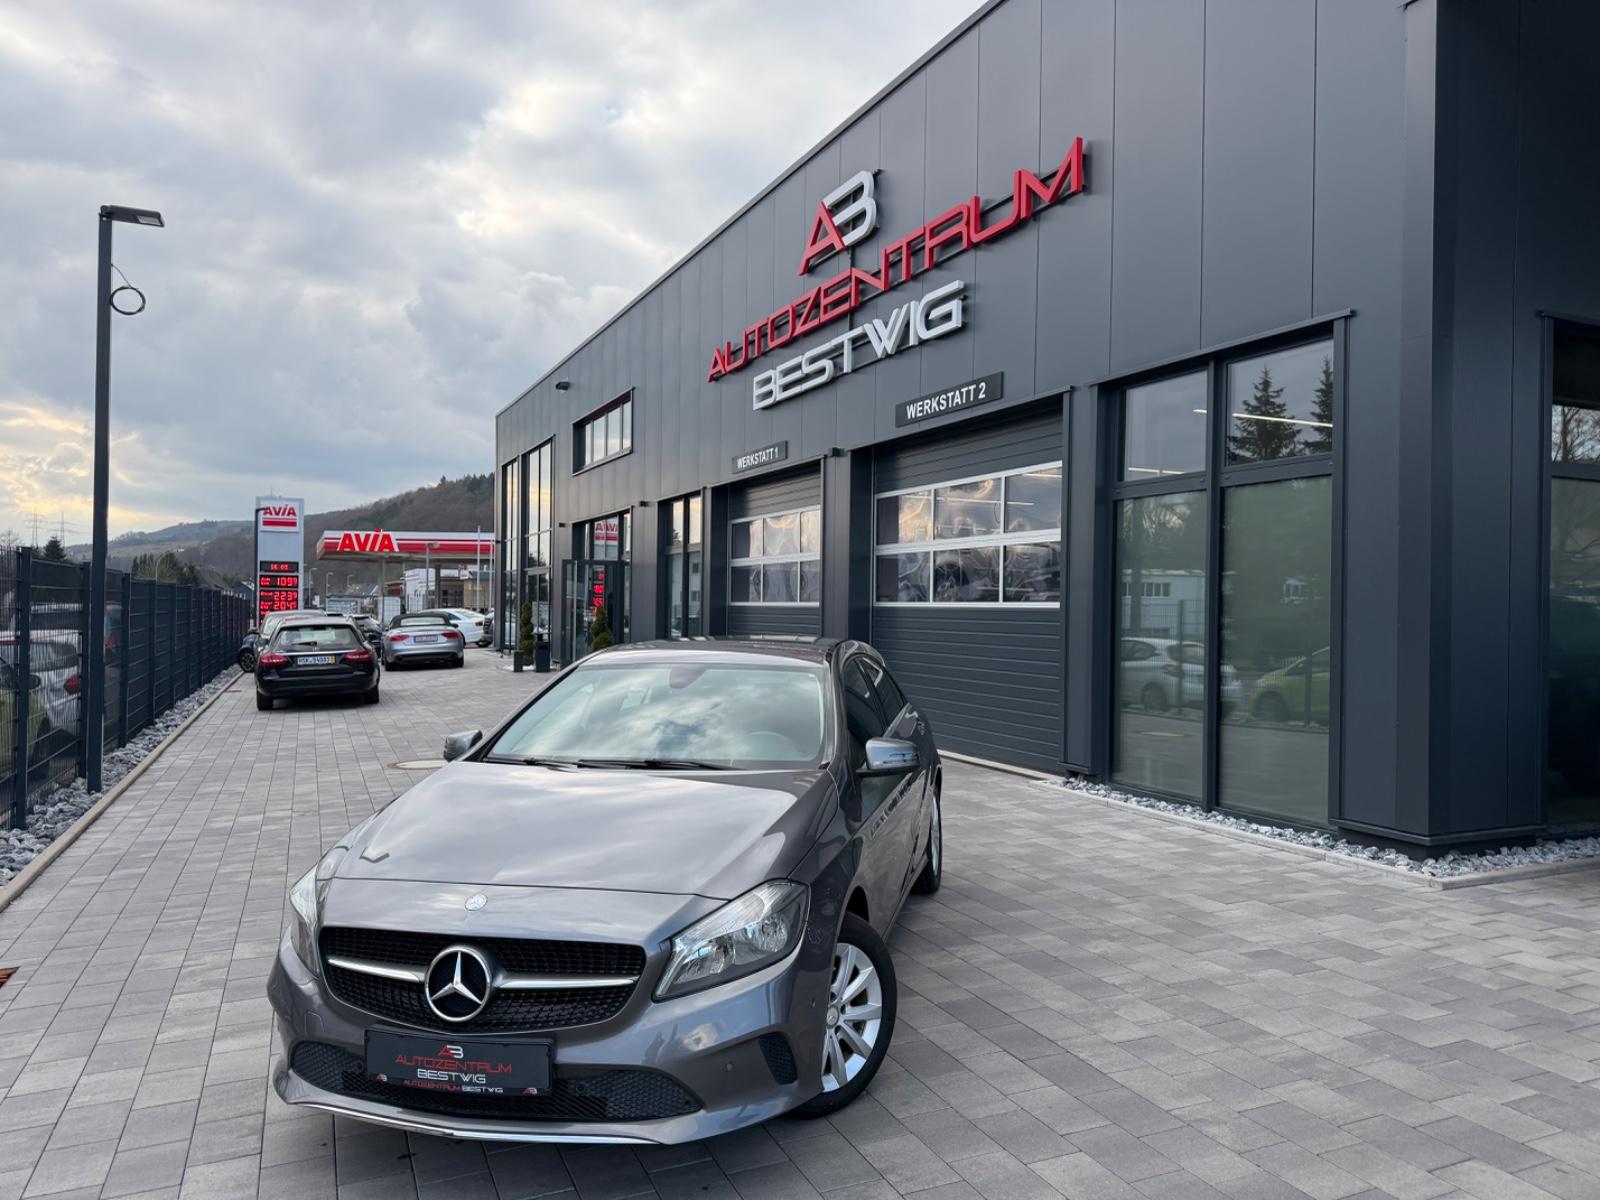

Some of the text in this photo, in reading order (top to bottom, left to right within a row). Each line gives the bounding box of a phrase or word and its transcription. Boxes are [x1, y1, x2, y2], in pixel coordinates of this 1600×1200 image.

[706, 135, 1084, 384] AUTOZENTRUM
[752, 279, 965, 412] BESTWIG
[906, 381, 987, 420] WERKSTATT 2
[736, 446, 779, 469] WERKSTATT 1
[262, 503, 297, 517] AVIA
[338, 527, 399, 552] AVIA
[395, 1054, 513, 1073] AUTOZENTRUM
[403, 1079, 504, 1094] AUTOZENTRUM BESTWIG
[417, 1068, 487, 1084] BESTWIG
